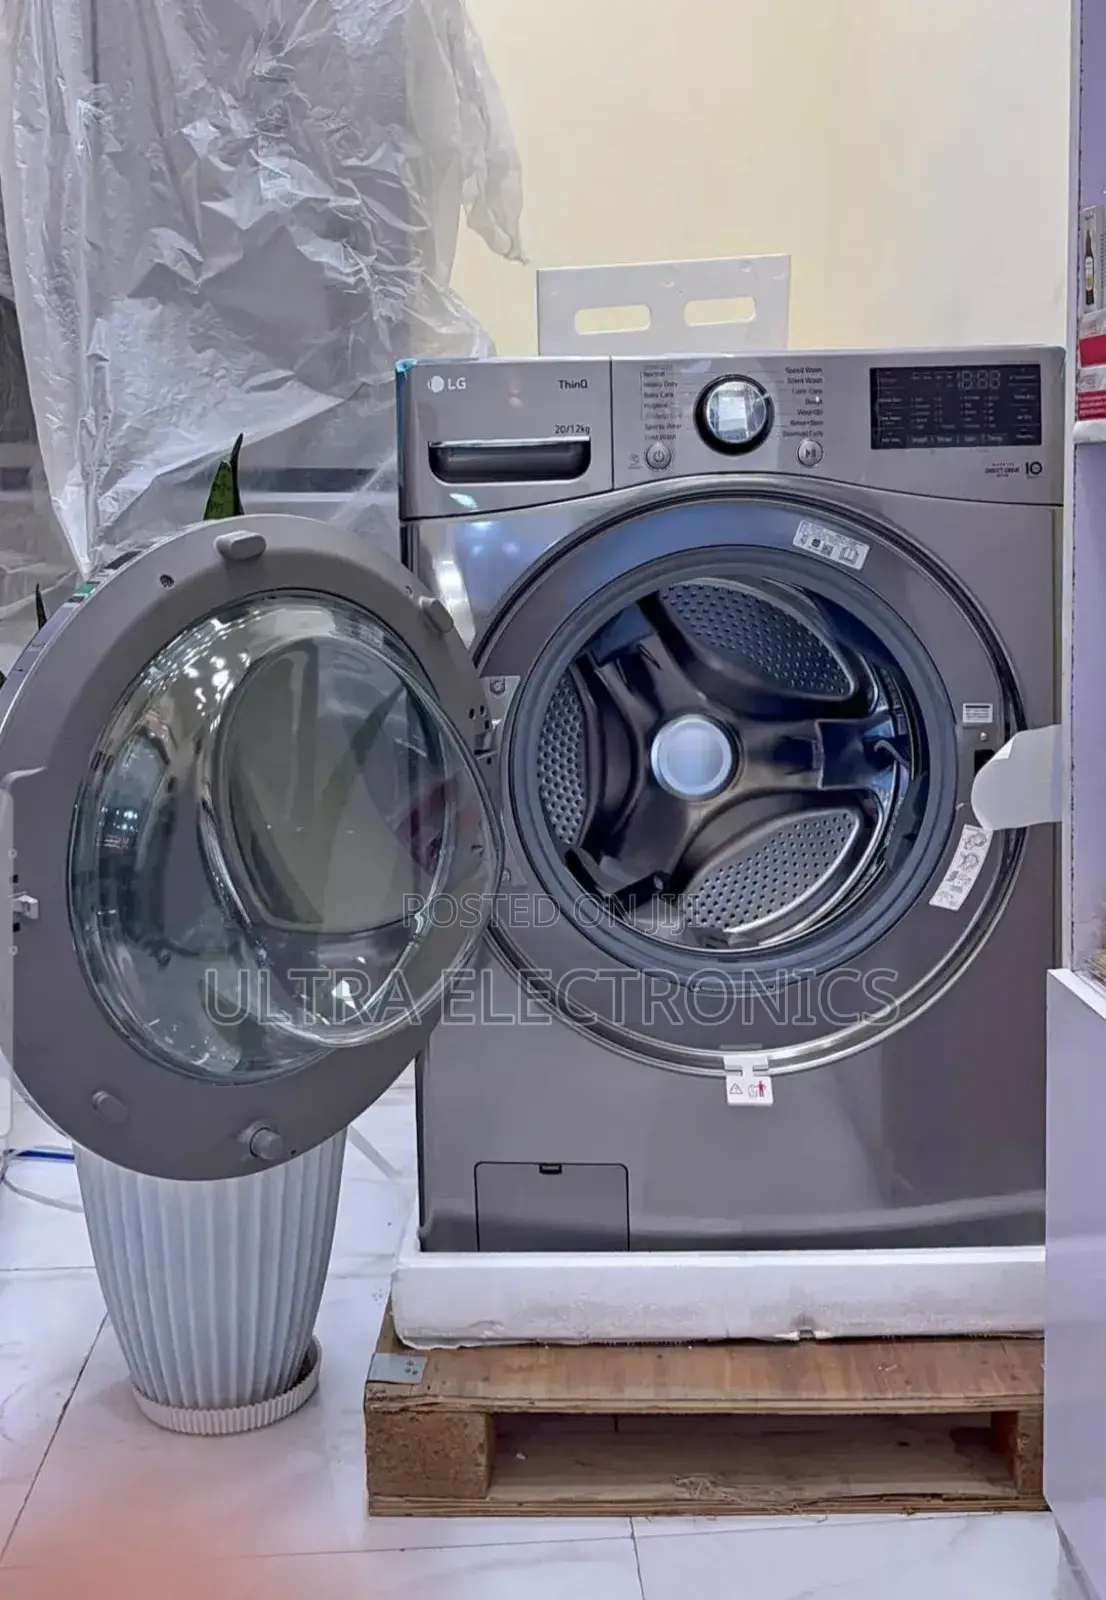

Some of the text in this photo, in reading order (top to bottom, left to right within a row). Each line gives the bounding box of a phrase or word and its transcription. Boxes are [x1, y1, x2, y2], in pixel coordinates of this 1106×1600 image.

[447, 377, 467, 390] LG
[558, 379, 588, 389] ThinQ
[554, 424, 590, 435] 20/12kg
